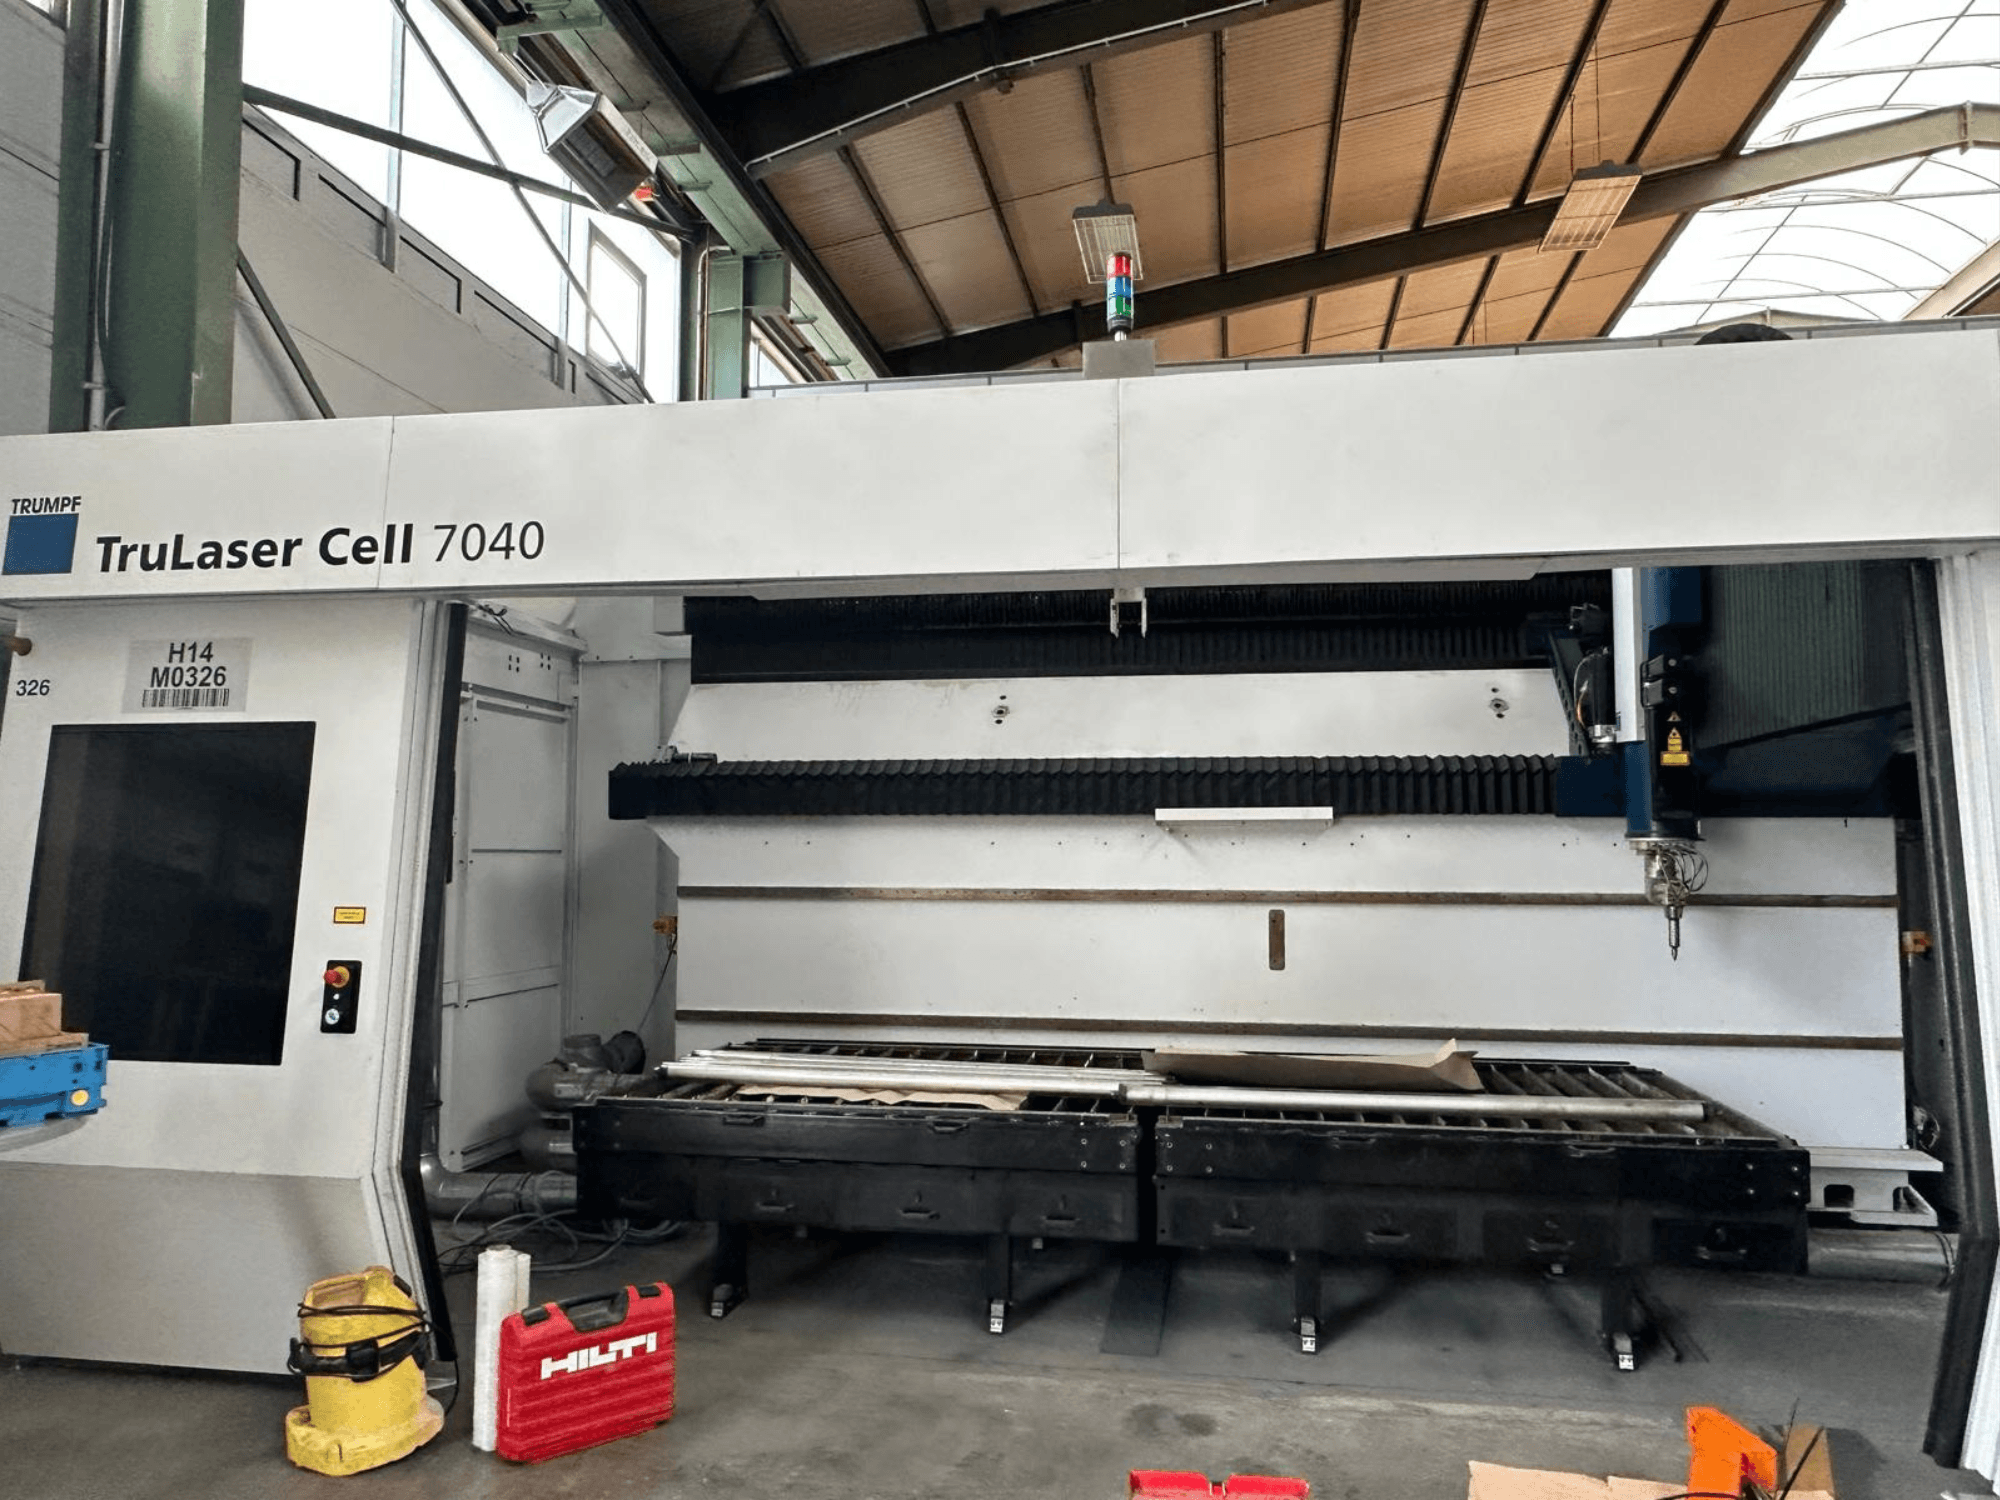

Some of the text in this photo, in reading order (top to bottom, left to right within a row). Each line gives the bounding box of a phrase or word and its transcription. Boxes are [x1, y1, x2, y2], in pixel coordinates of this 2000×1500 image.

[11, 495, 82, 515] TRUMPF
[97, 520, 545, 573] TruLaser Cell 7040
[168, 641, 214, 663] H14
[150, 665, 227, 688] M0326
[16, 679, 51, 697] 326
[540, 1331, 658, 1381] HILTI
